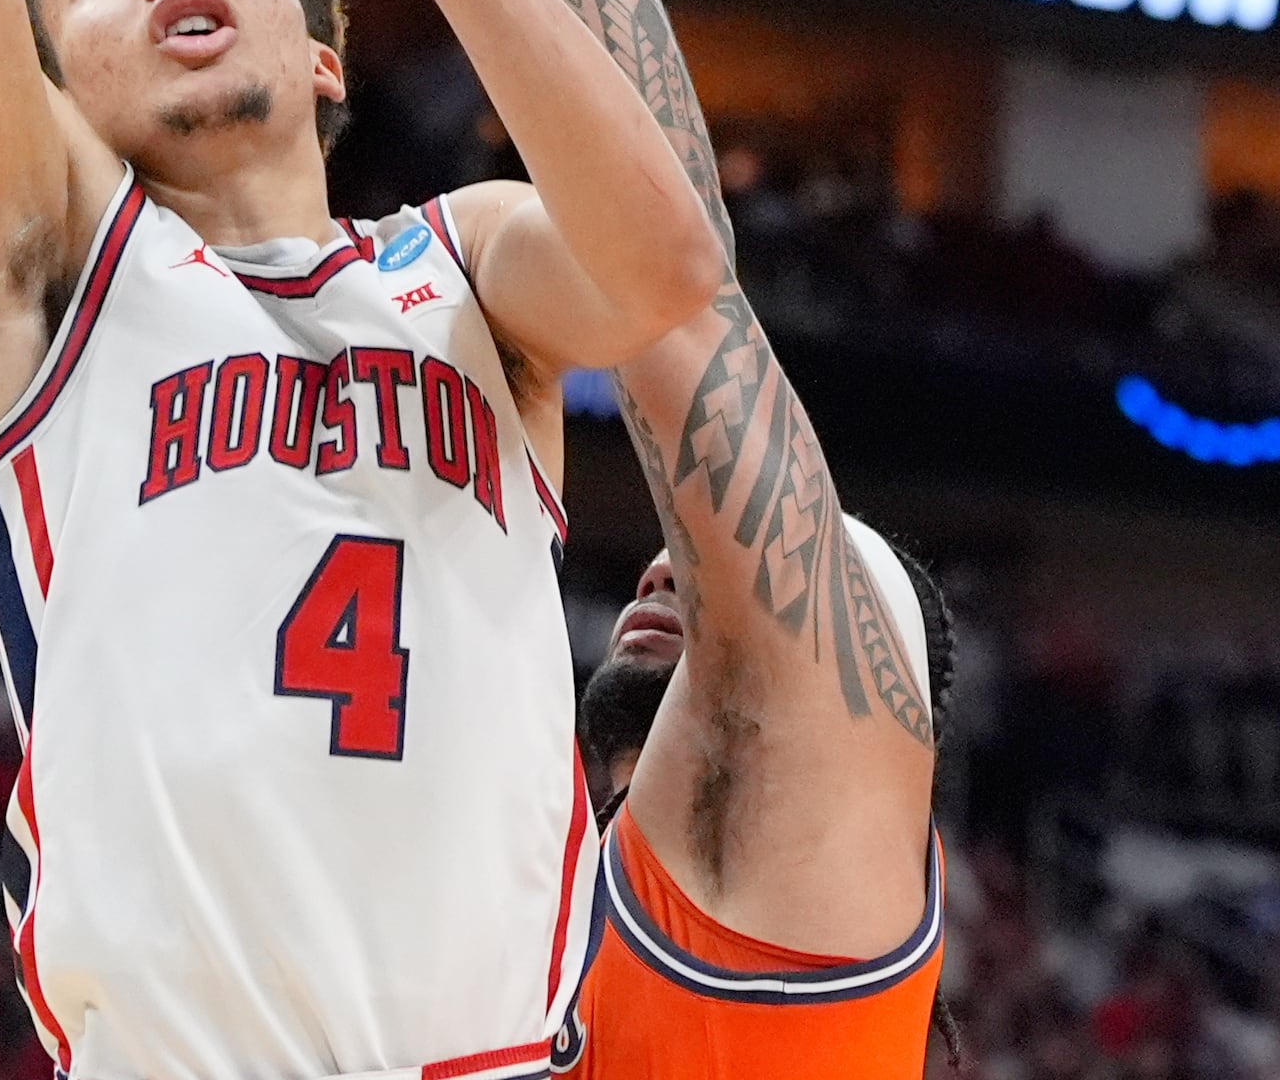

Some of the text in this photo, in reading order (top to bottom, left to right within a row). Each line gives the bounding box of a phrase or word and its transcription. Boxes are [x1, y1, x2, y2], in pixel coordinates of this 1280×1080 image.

[387, 228, 430, 267] NCAA
[391, 282, 443, 314] XII
[138, 345, 508, 536] HOUSTON
[273, 533, 410, 762] 4
